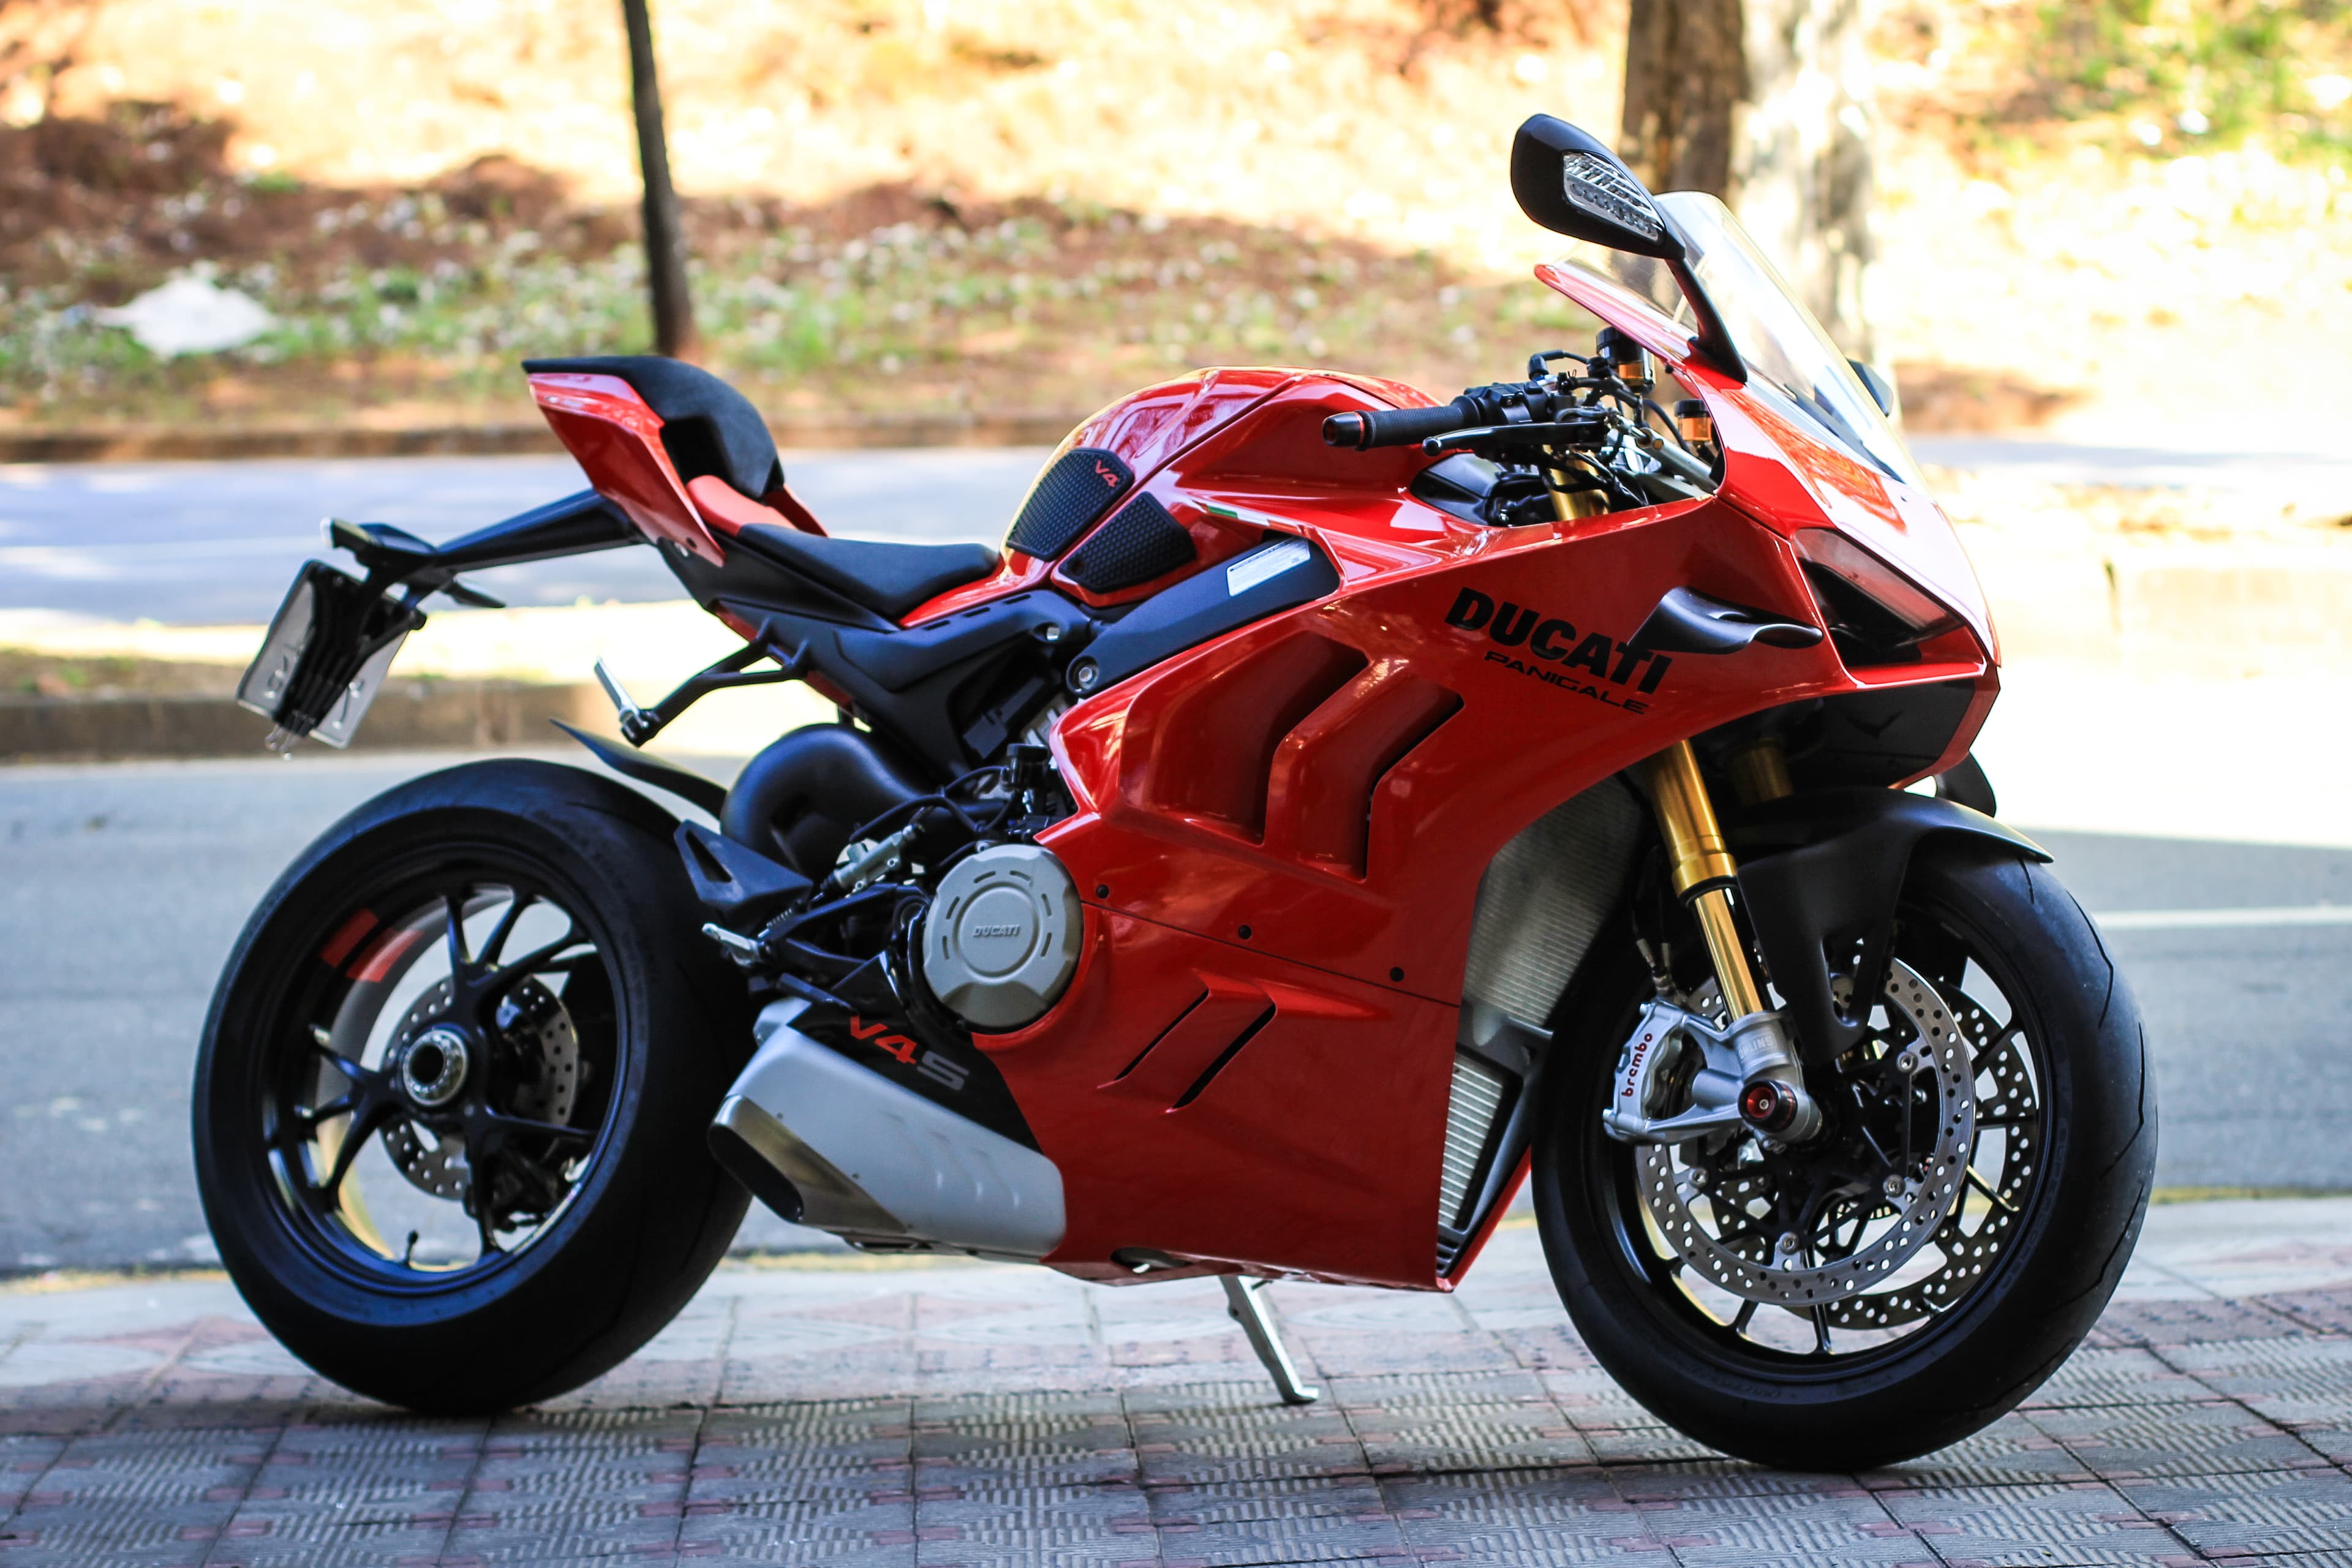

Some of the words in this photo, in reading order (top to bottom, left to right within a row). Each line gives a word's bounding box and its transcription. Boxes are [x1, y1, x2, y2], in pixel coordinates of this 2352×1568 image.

[1095, 460, 1118, 488] V4
[1444, 587, 1673, 695] DUCATI
[1483, 650, 1649, 715] PANIGALE
[972, 924, 1020, 938] DUCATI
[1621, 1033, 1653, 1097] brembo
